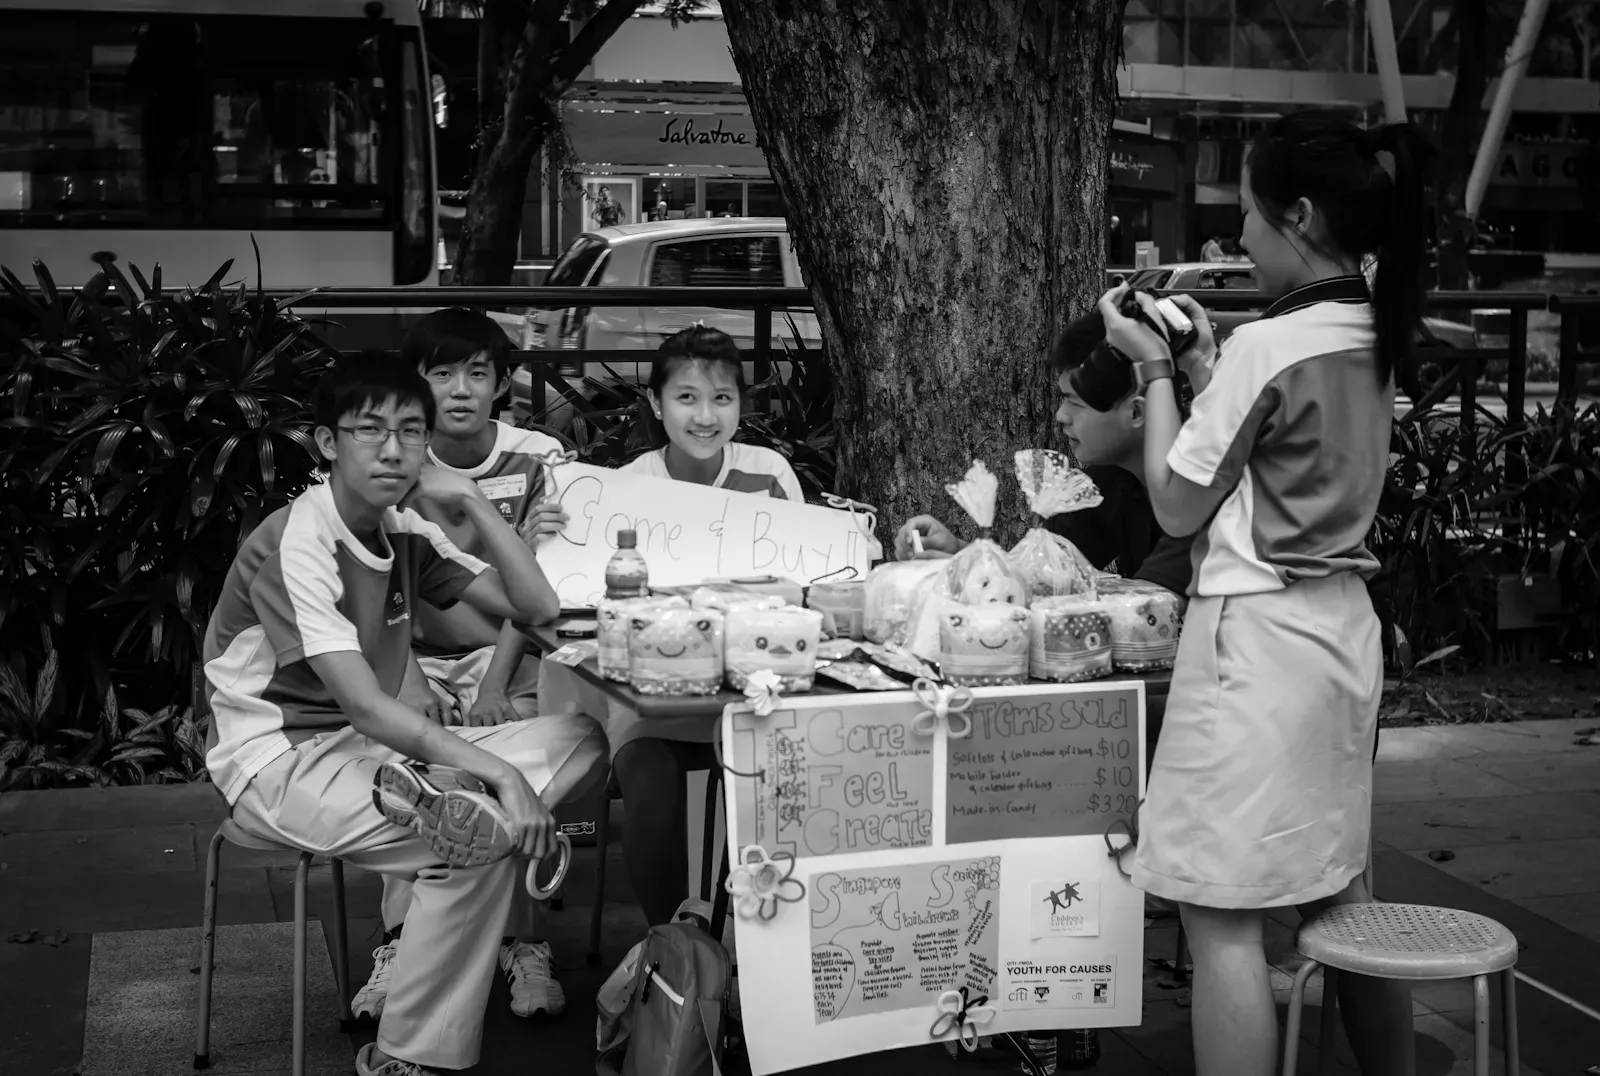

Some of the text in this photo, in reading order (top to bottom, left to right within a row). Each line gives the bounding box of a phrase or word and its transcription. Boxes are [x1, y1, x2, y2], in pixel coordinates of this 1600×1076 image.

[658, 117, 751, 146] Salvatore
[558, 475, 683, 560] Come
[807, 709, 905, 757] Care
[1097, 737, 1130, 760] $10
[1007, 966, 1042, 976] YOUTH
[1045, 966, 1067, 974] FOR
[1069, 965, 1112, 974] CAUSES
[1008, 987, 1028, 1002] citi
